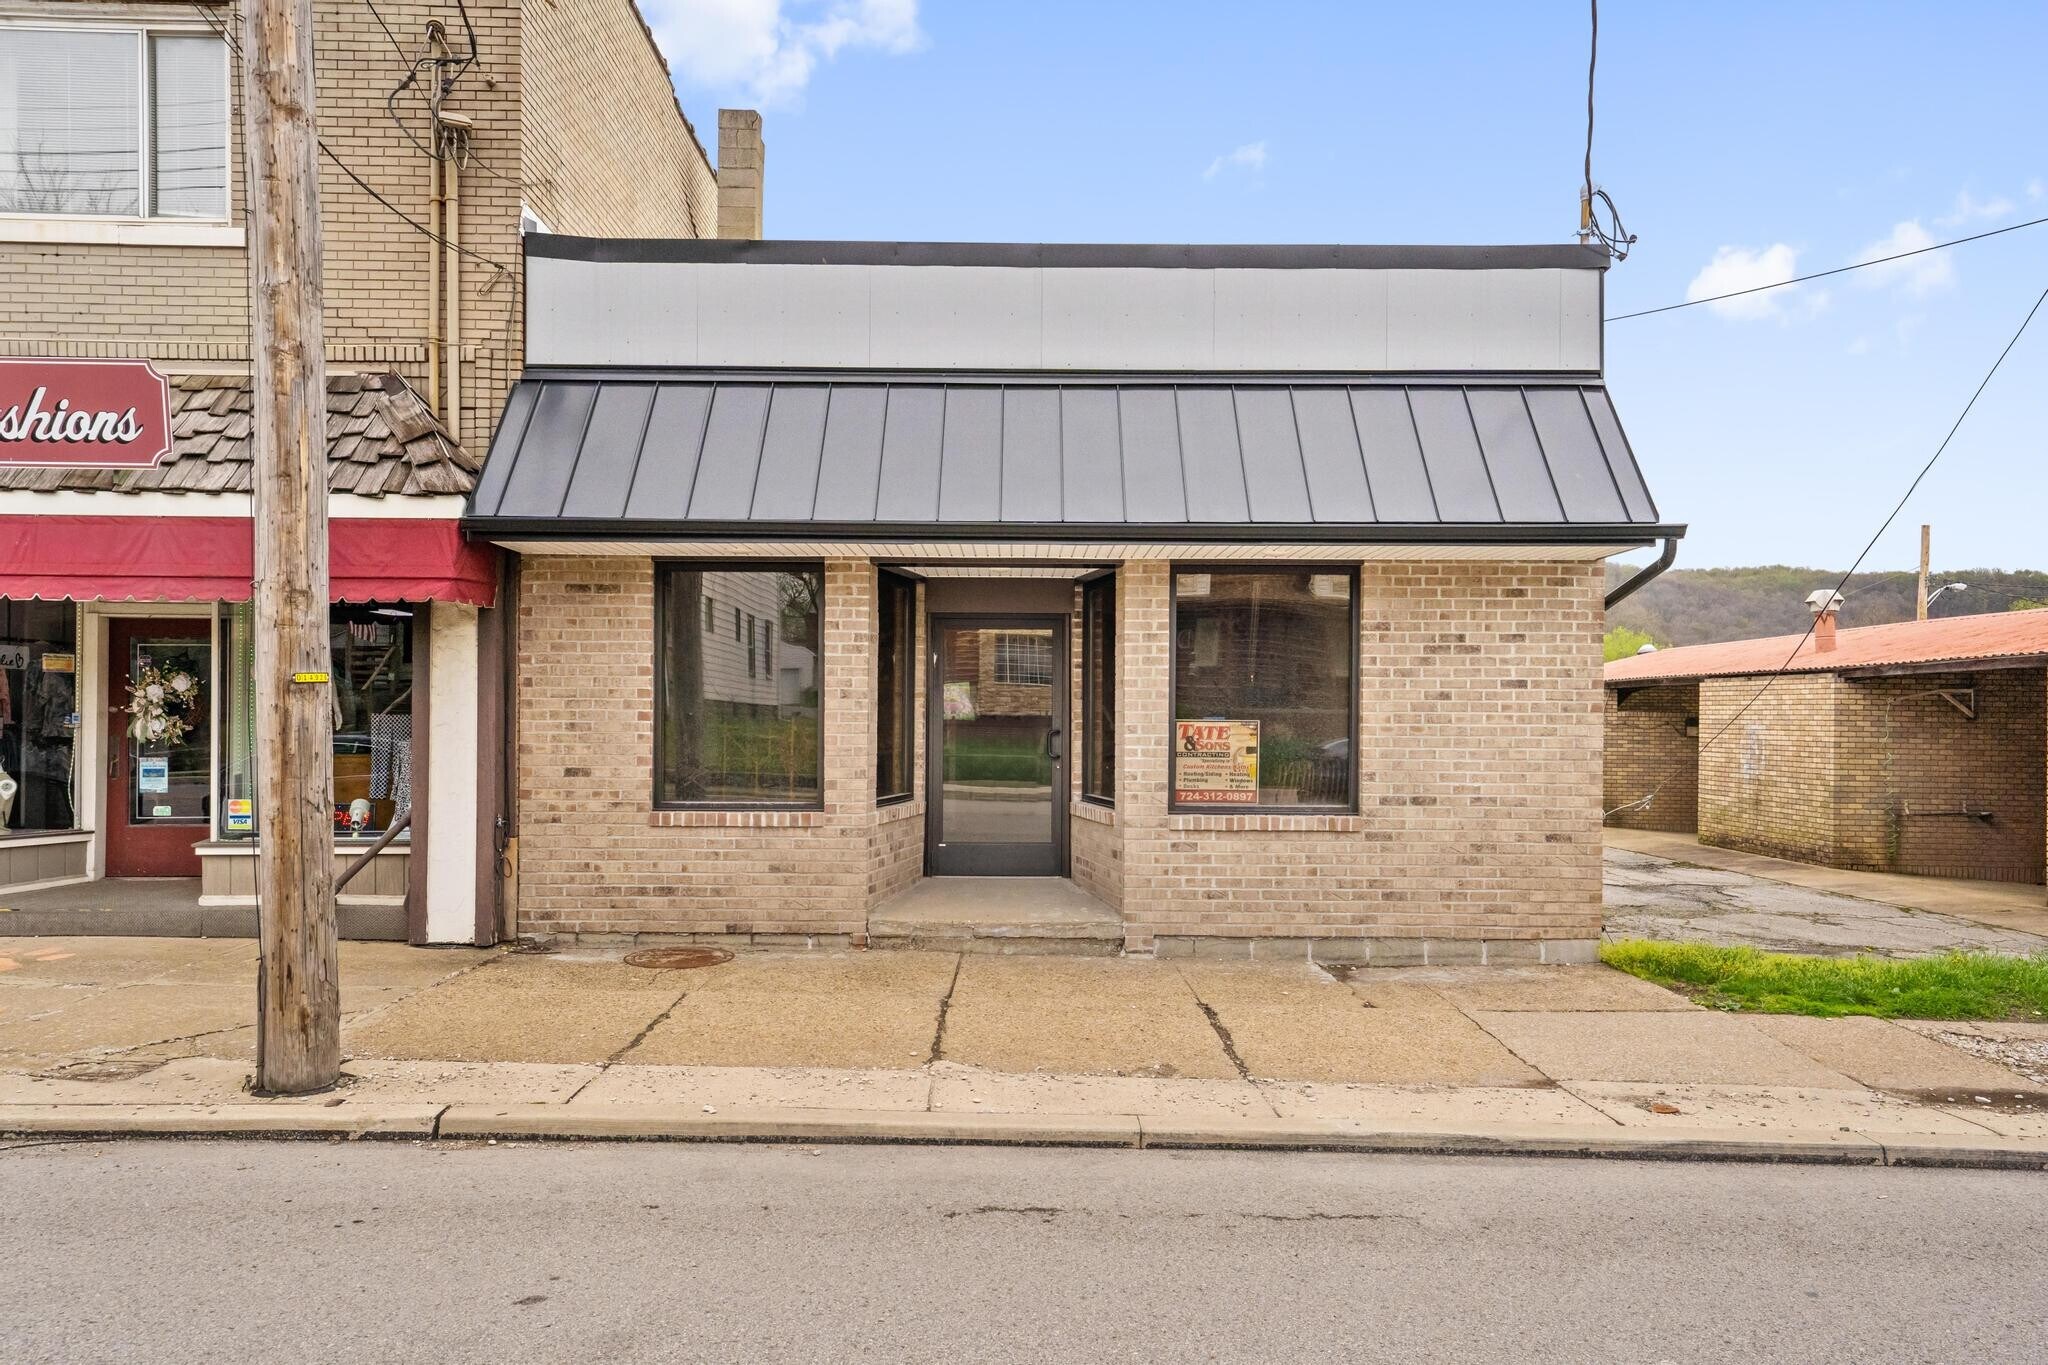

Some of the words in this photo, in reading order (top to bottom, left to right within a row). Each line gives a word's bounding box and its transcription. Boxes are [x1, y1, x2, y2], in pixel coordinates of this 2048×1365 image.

[1178, 724, 1231, 741] TATE
[1184, 735, 1196, 751] &
[1180, 792, 1253, 801] 724-312-0897
